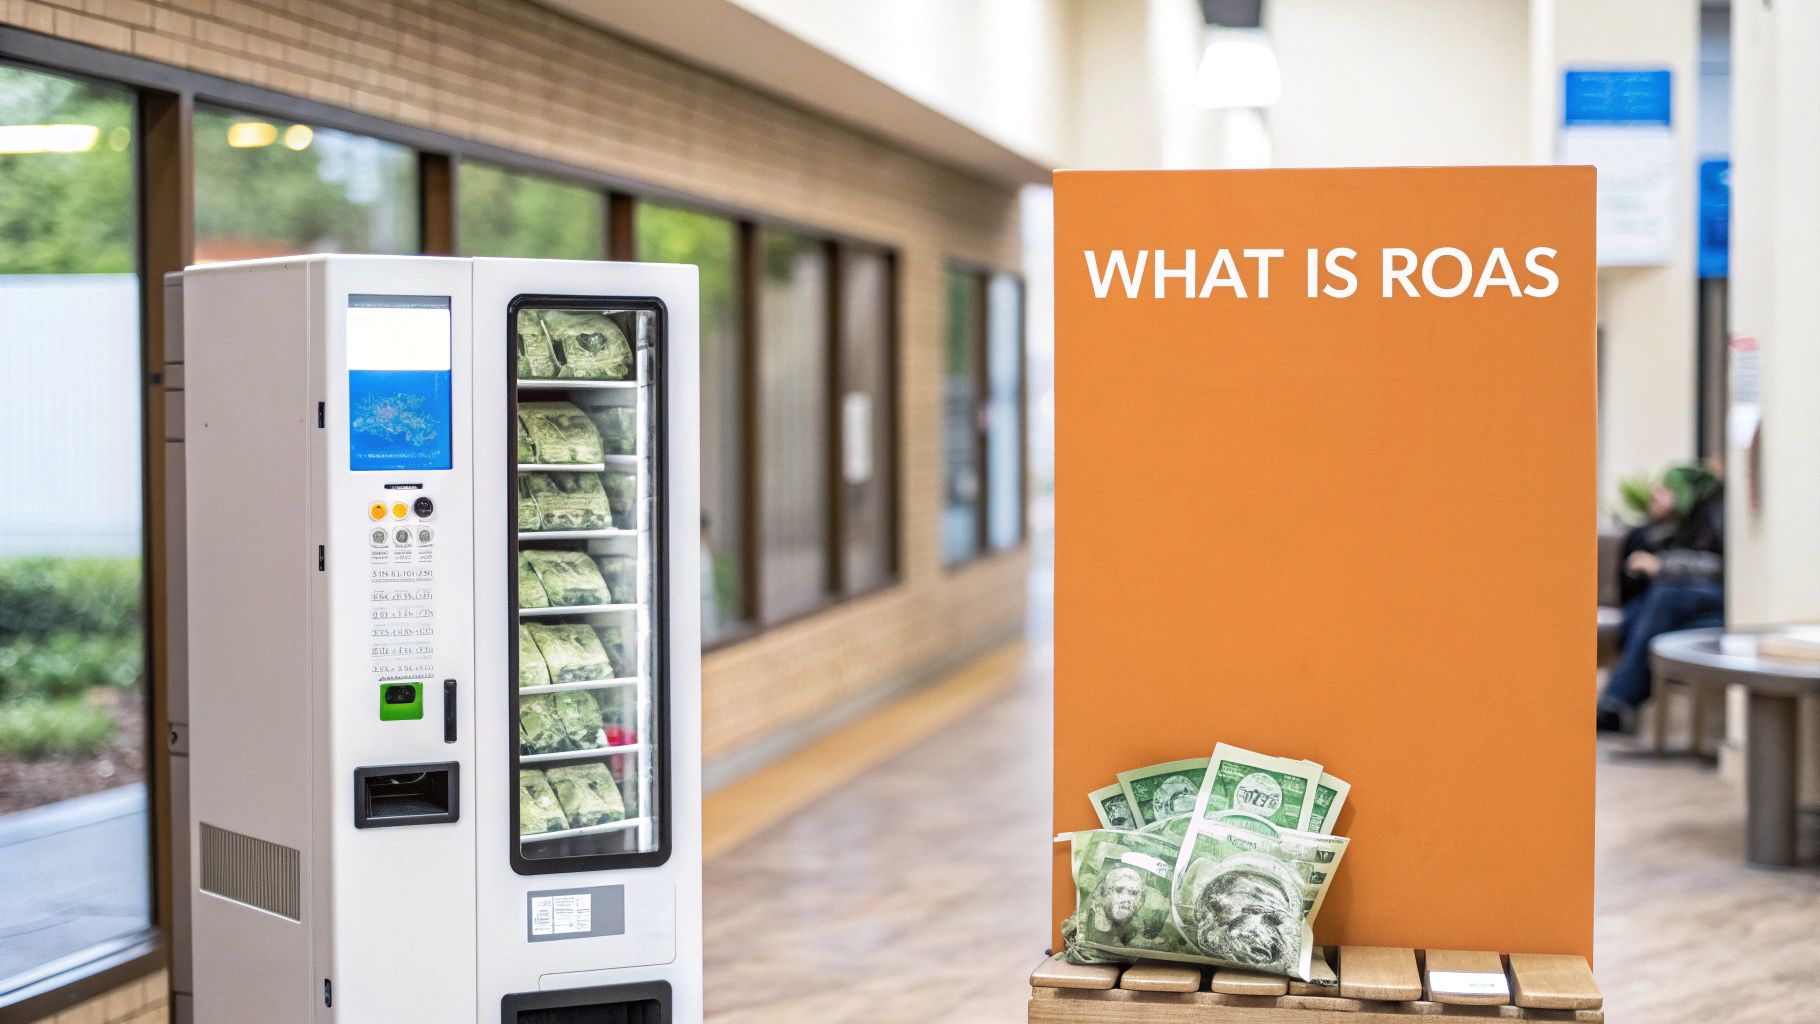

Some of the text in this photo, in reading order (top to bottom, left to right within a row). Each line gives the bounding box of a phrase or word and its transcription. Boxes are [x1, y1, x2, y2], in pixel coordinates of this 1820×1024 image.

[1084, 247, 1560, 298] WHAT IS ROAS
